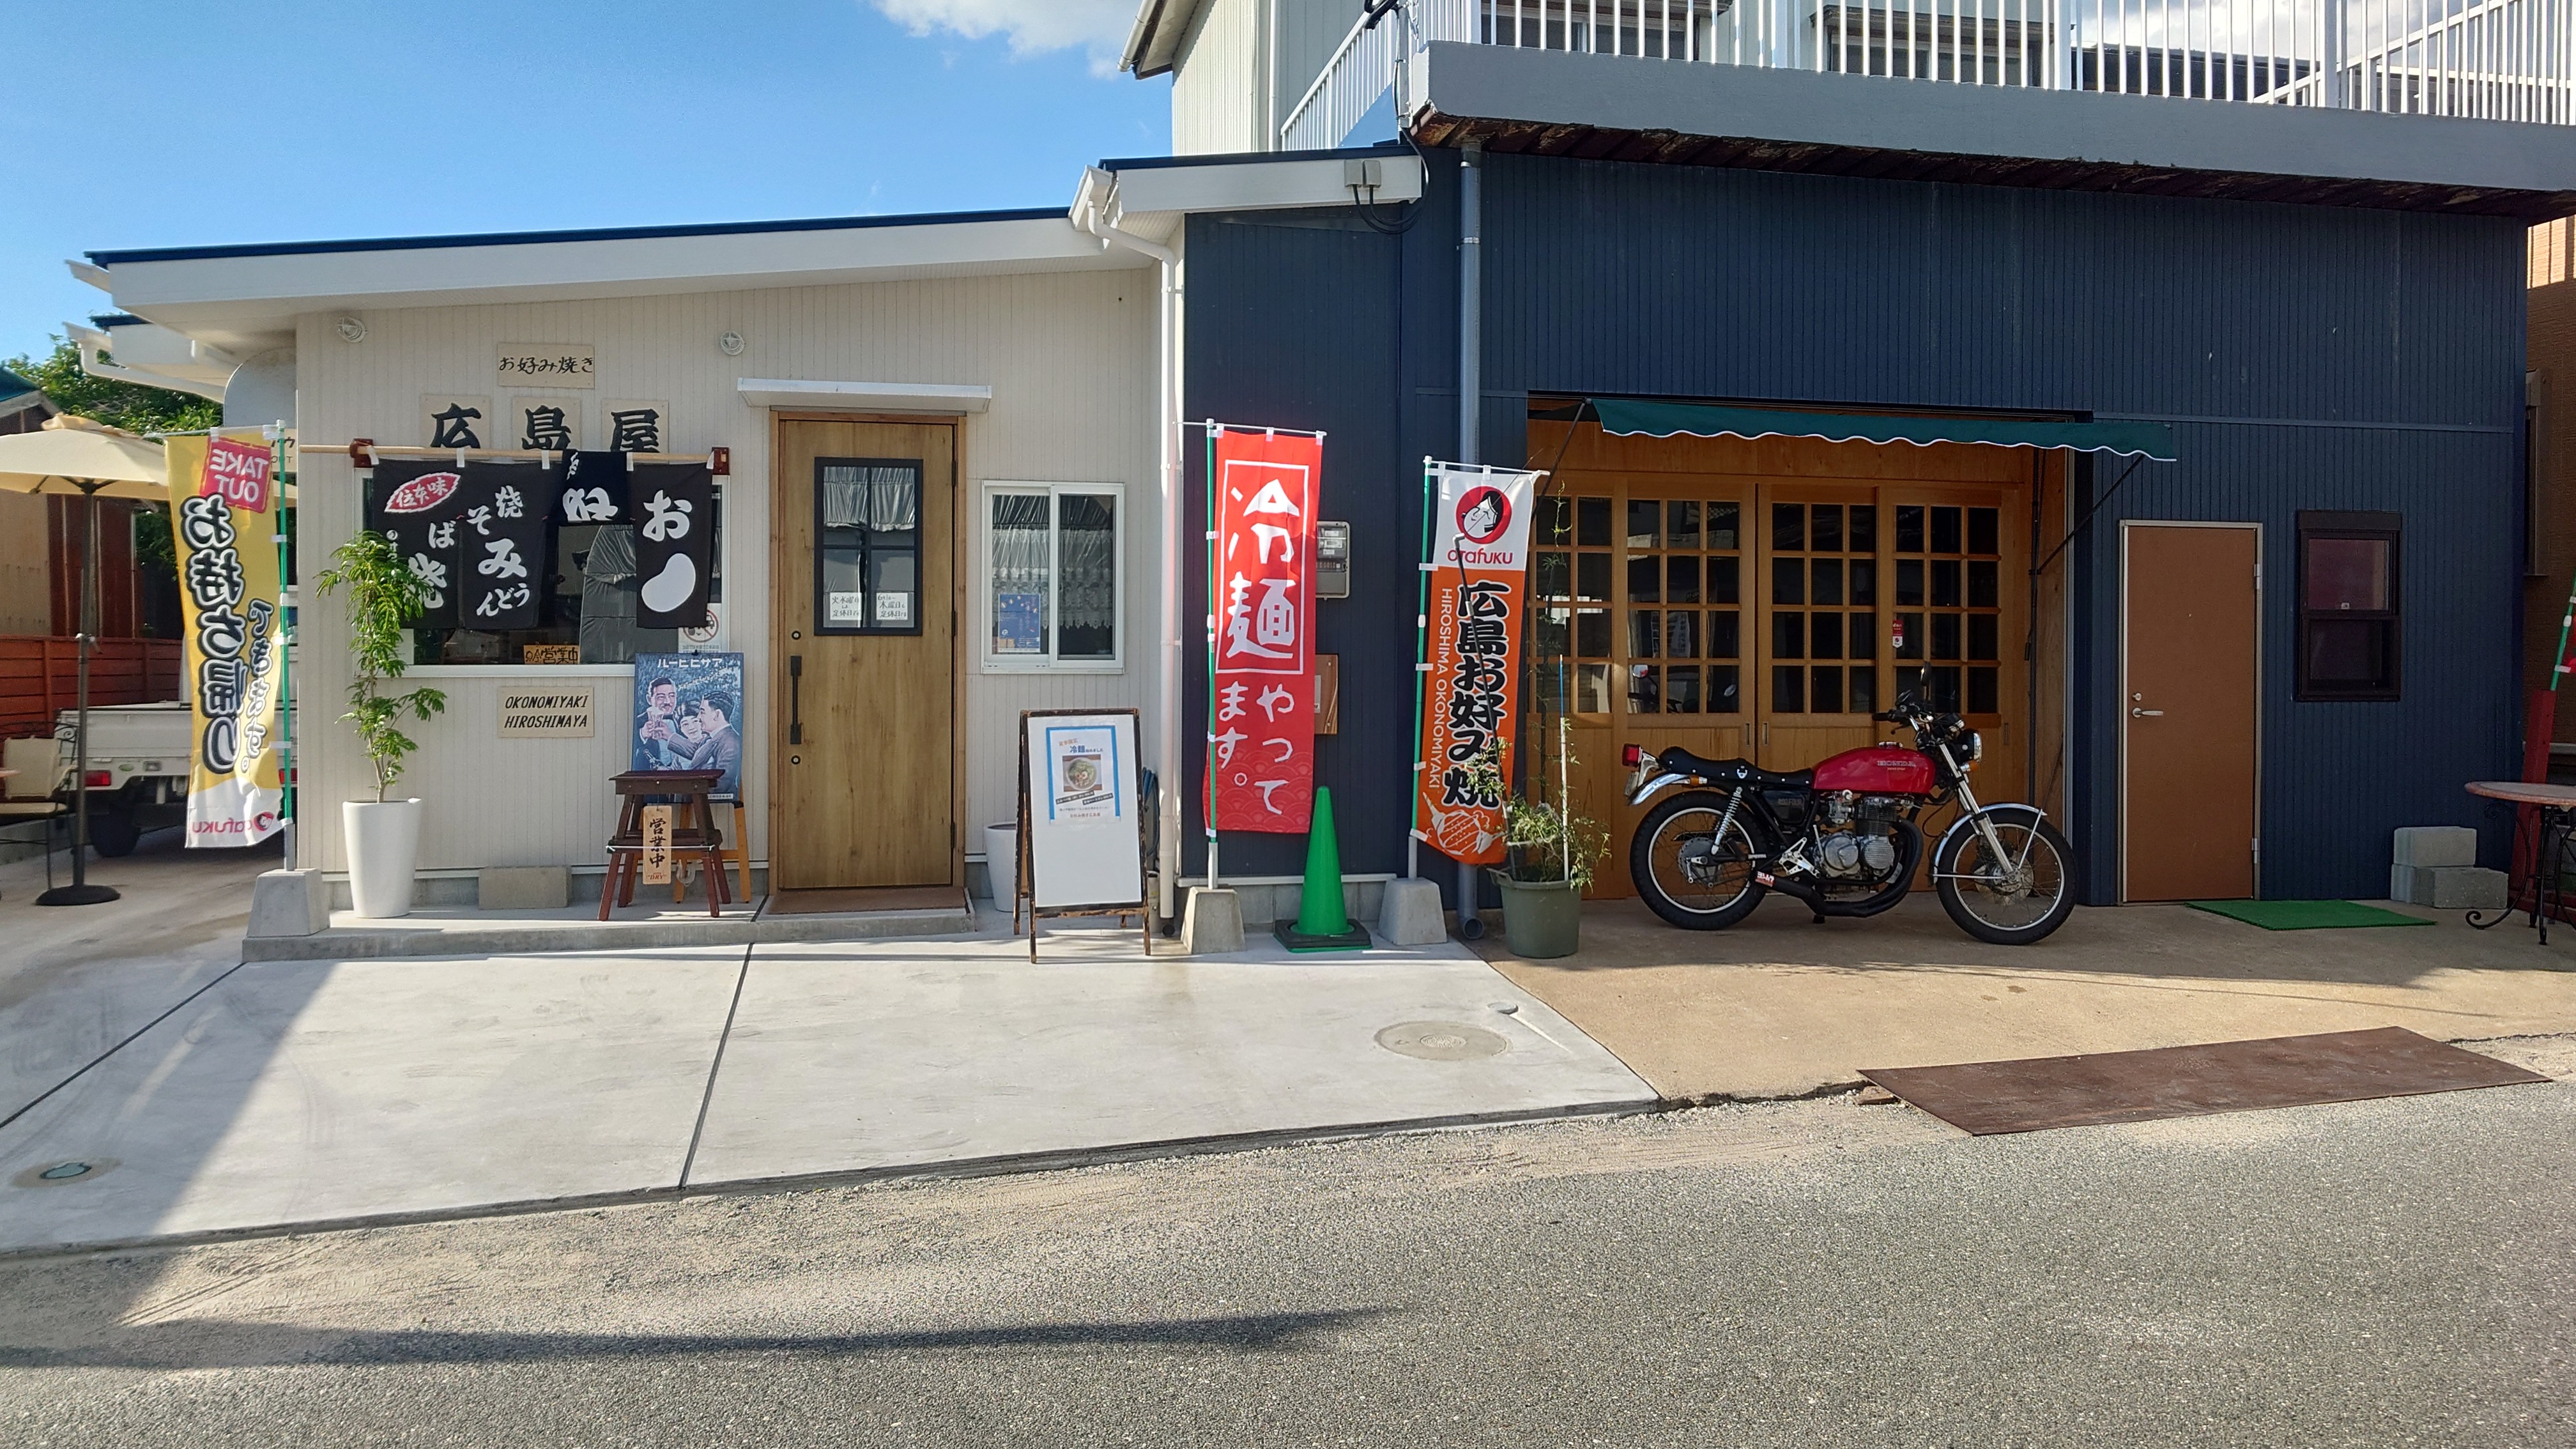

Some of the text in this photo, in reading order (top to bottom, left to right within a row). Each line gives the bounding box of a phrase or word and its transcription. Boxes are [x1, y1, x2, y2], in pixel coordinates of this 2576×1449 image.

[499, 356, 594, 374] お好み焼き
[431, 402, 660, 453] 広島屋
[271, 456, 293, 464] OT
[1226, 479, 1300, 659] 冷麺
[505, 695, 588, 709] OKONOMIYAKI
[1429, 588, 1453, 788] HIROSHIMA OKONOMIYAKI
[504, 714, 587, 728] HIROSHIMAYA
[1255, 684, 1294, 815] やって
[649, 818, 666, 868] 営業中
